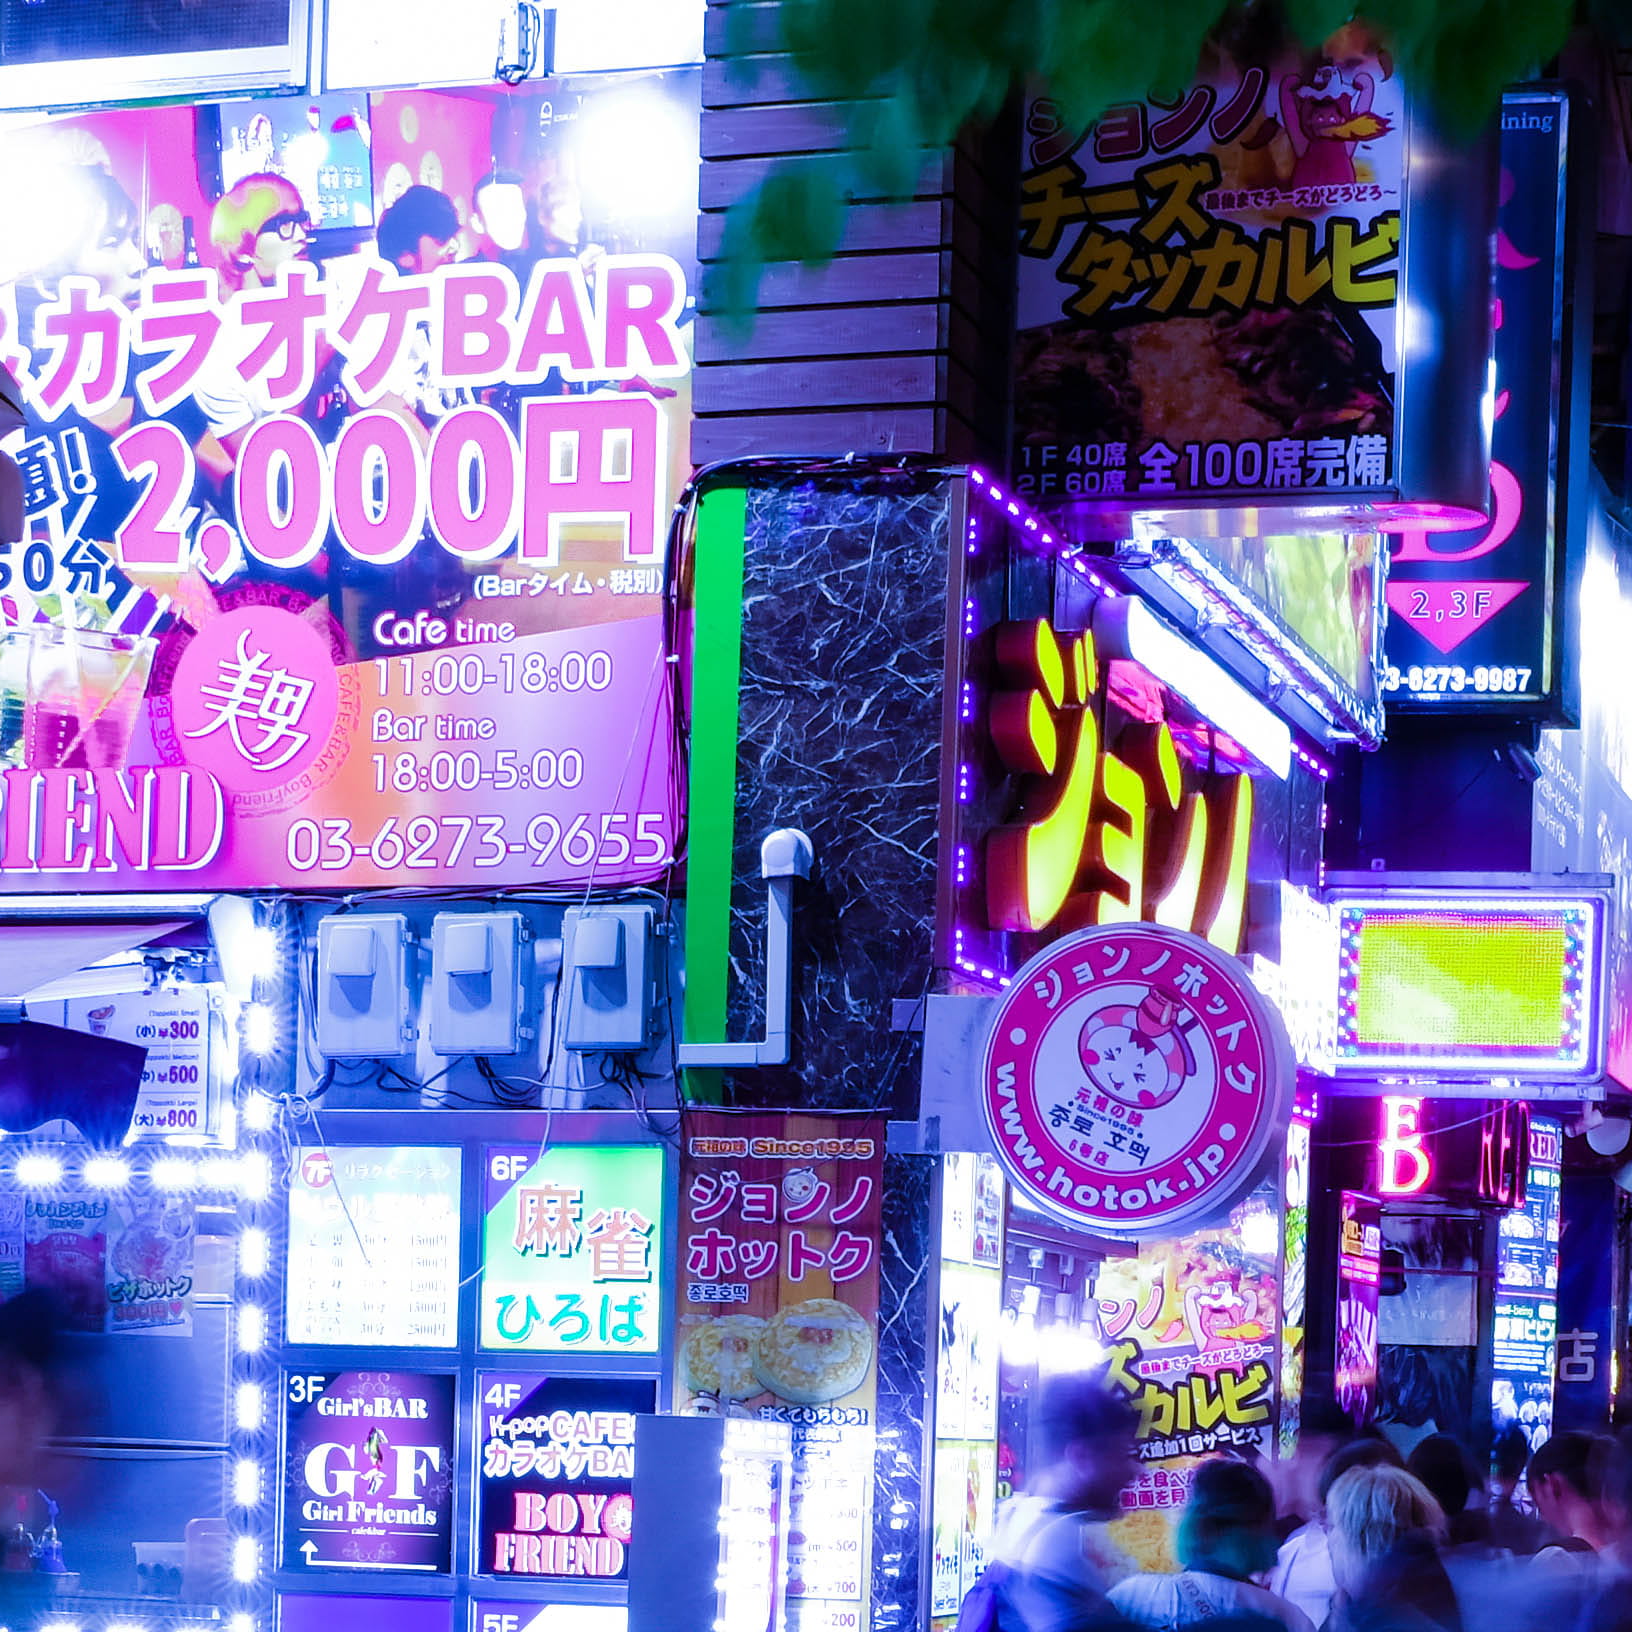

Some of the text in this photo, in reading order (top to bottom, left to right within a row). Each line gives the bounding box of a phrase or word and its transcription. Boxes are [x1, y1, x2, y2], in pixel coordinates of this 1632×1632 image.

[1019, 154, 1221, 259] チーズ
[1057, 213, 1400, 318] タッカルビ
[374, 611, 517, 645] Cafe time
[375, 651, 612, 696] 11:00-18:00
[1381, 667, 1533, 694] 3-6273-9987
[372, 708, 496, 741] Bar time
[372, 748, 583, 792] 18:00-5:00
[286, 813, 667, 871] 03-6273-9655
[995, 1061, 1227, 1211] www.hotok.jp
[491, 1155, 528, 1182] 6F
[689, 1170, 873, 1225] ジョンノ
[513, 1183, 655, 1284] 麻雀
[687, 1227, 872, 1282] ホットク
[495, 1292, 648, 1346] ひろば
[289, 1375, 326, 1403] 3F
[484, 1384, 522, 1409] 4F
[303, 1499, 437, 1525] Girl Friends
[514, 1491, 607, 1534] BOY
[494, 1533, 624, 1577] FRIEND
